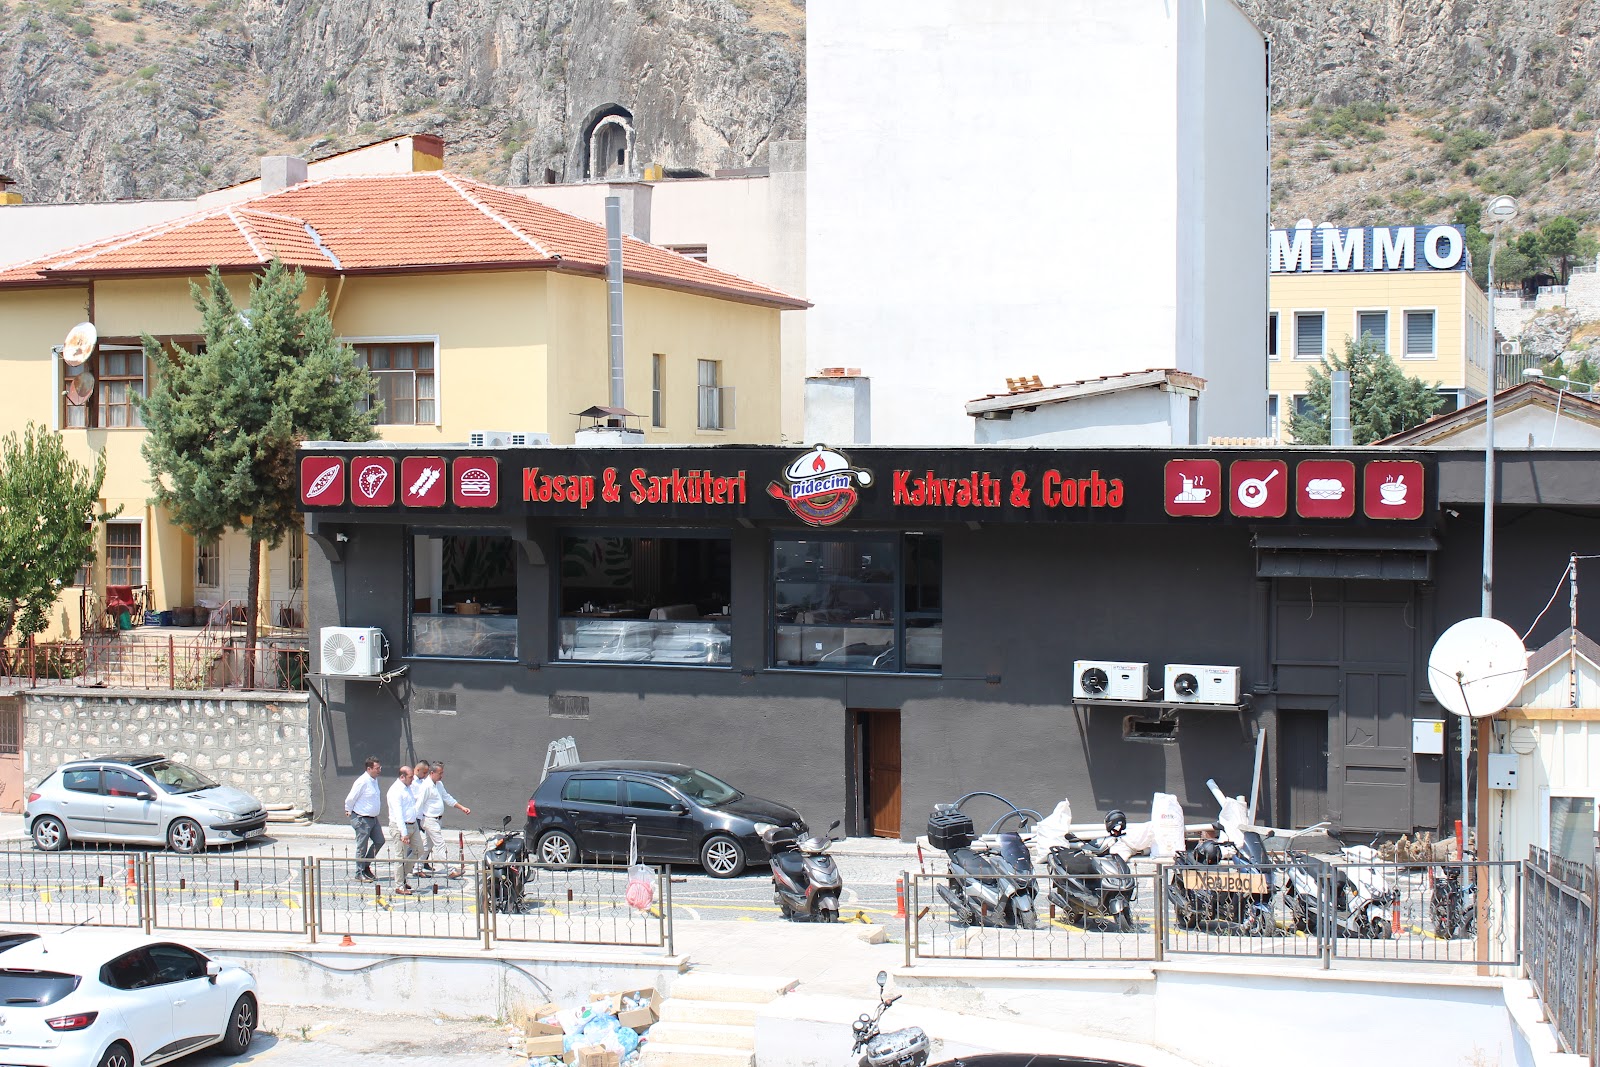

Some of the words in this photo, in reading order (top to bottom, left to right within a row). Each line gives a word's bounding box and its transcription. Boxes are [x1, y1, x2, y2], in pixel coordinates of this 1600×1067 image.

[1271, 226, 1462, 271] MMMO
[523, 467, 595, 509] Kasap
[602, 467, 621, 502] &
[791, 476, 849, 498] pidecim
[893, 469, 1001, 507] Kahvaltı
[1010, 470, 1031, 508] &
